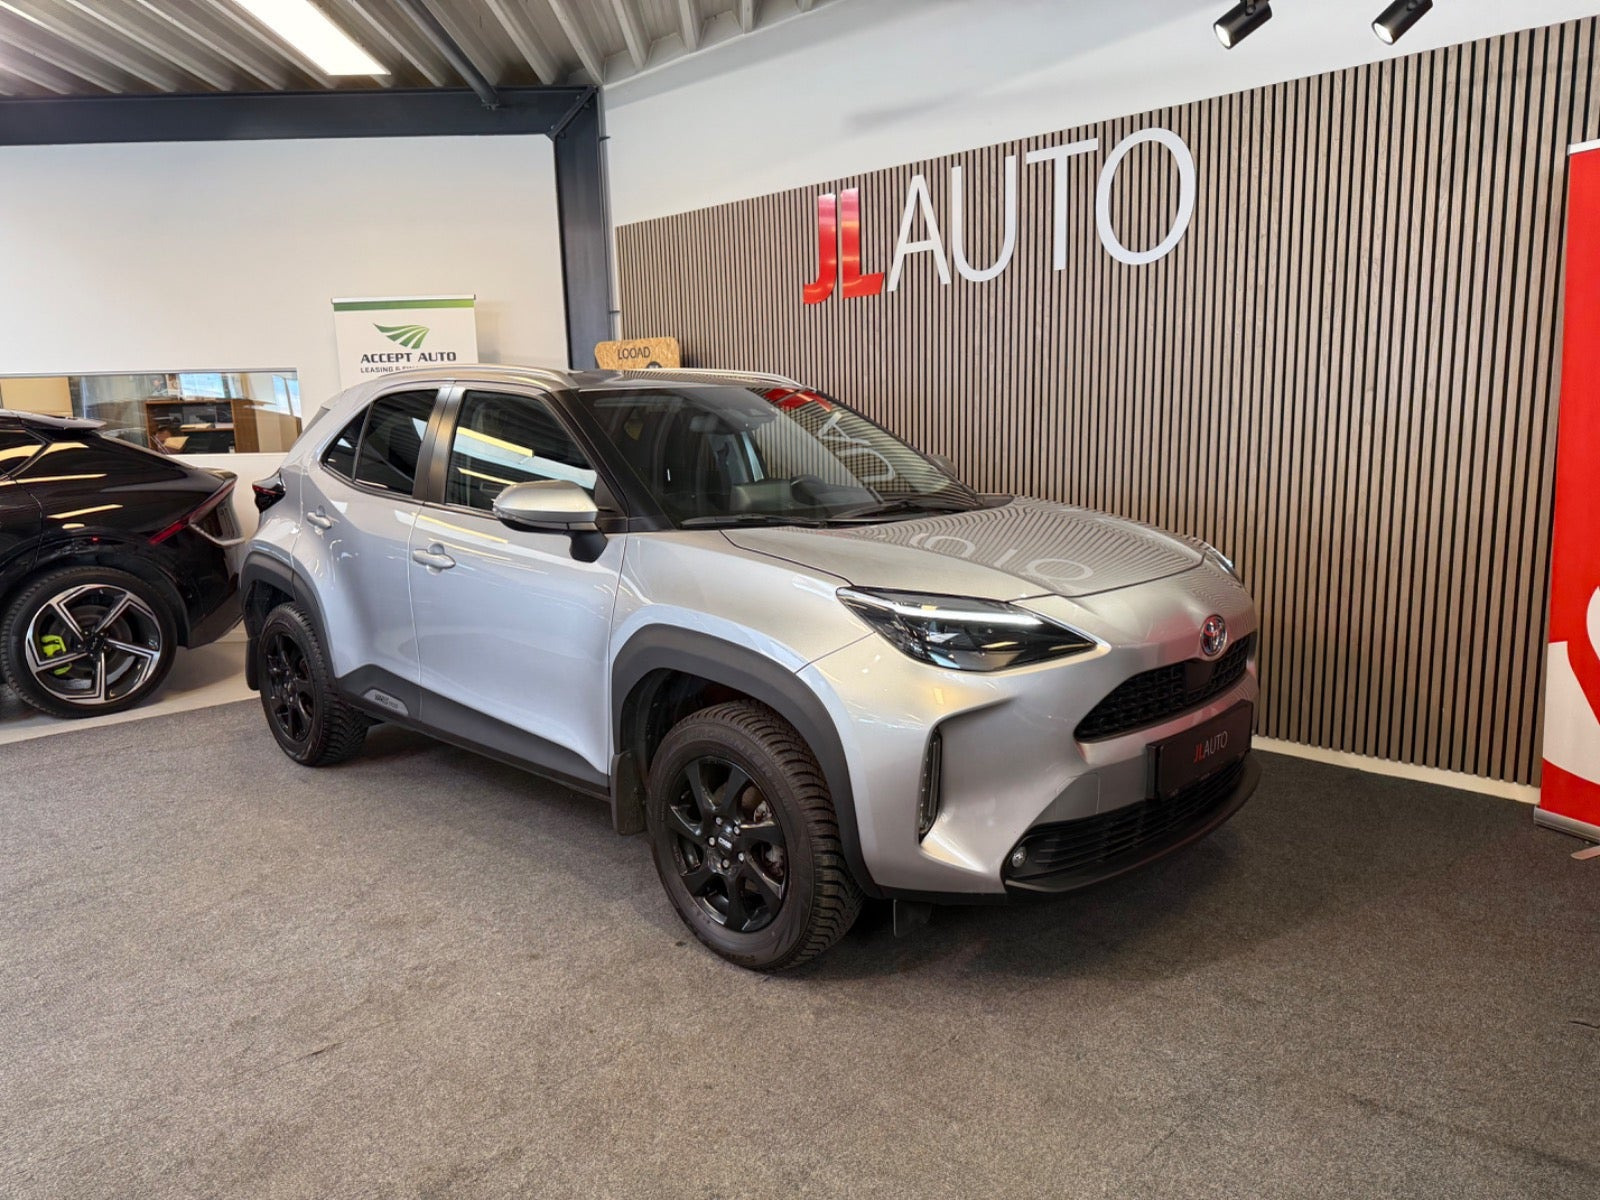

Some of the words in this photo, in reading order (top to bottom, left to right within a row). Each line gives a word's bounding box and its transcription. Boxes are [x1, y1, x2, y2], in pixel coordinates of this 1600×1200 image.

[361, 352, 412, 363] ACCEPT
[418, 351, 457, 362] AUTO
[360, 365, 394, 374] LEASING
